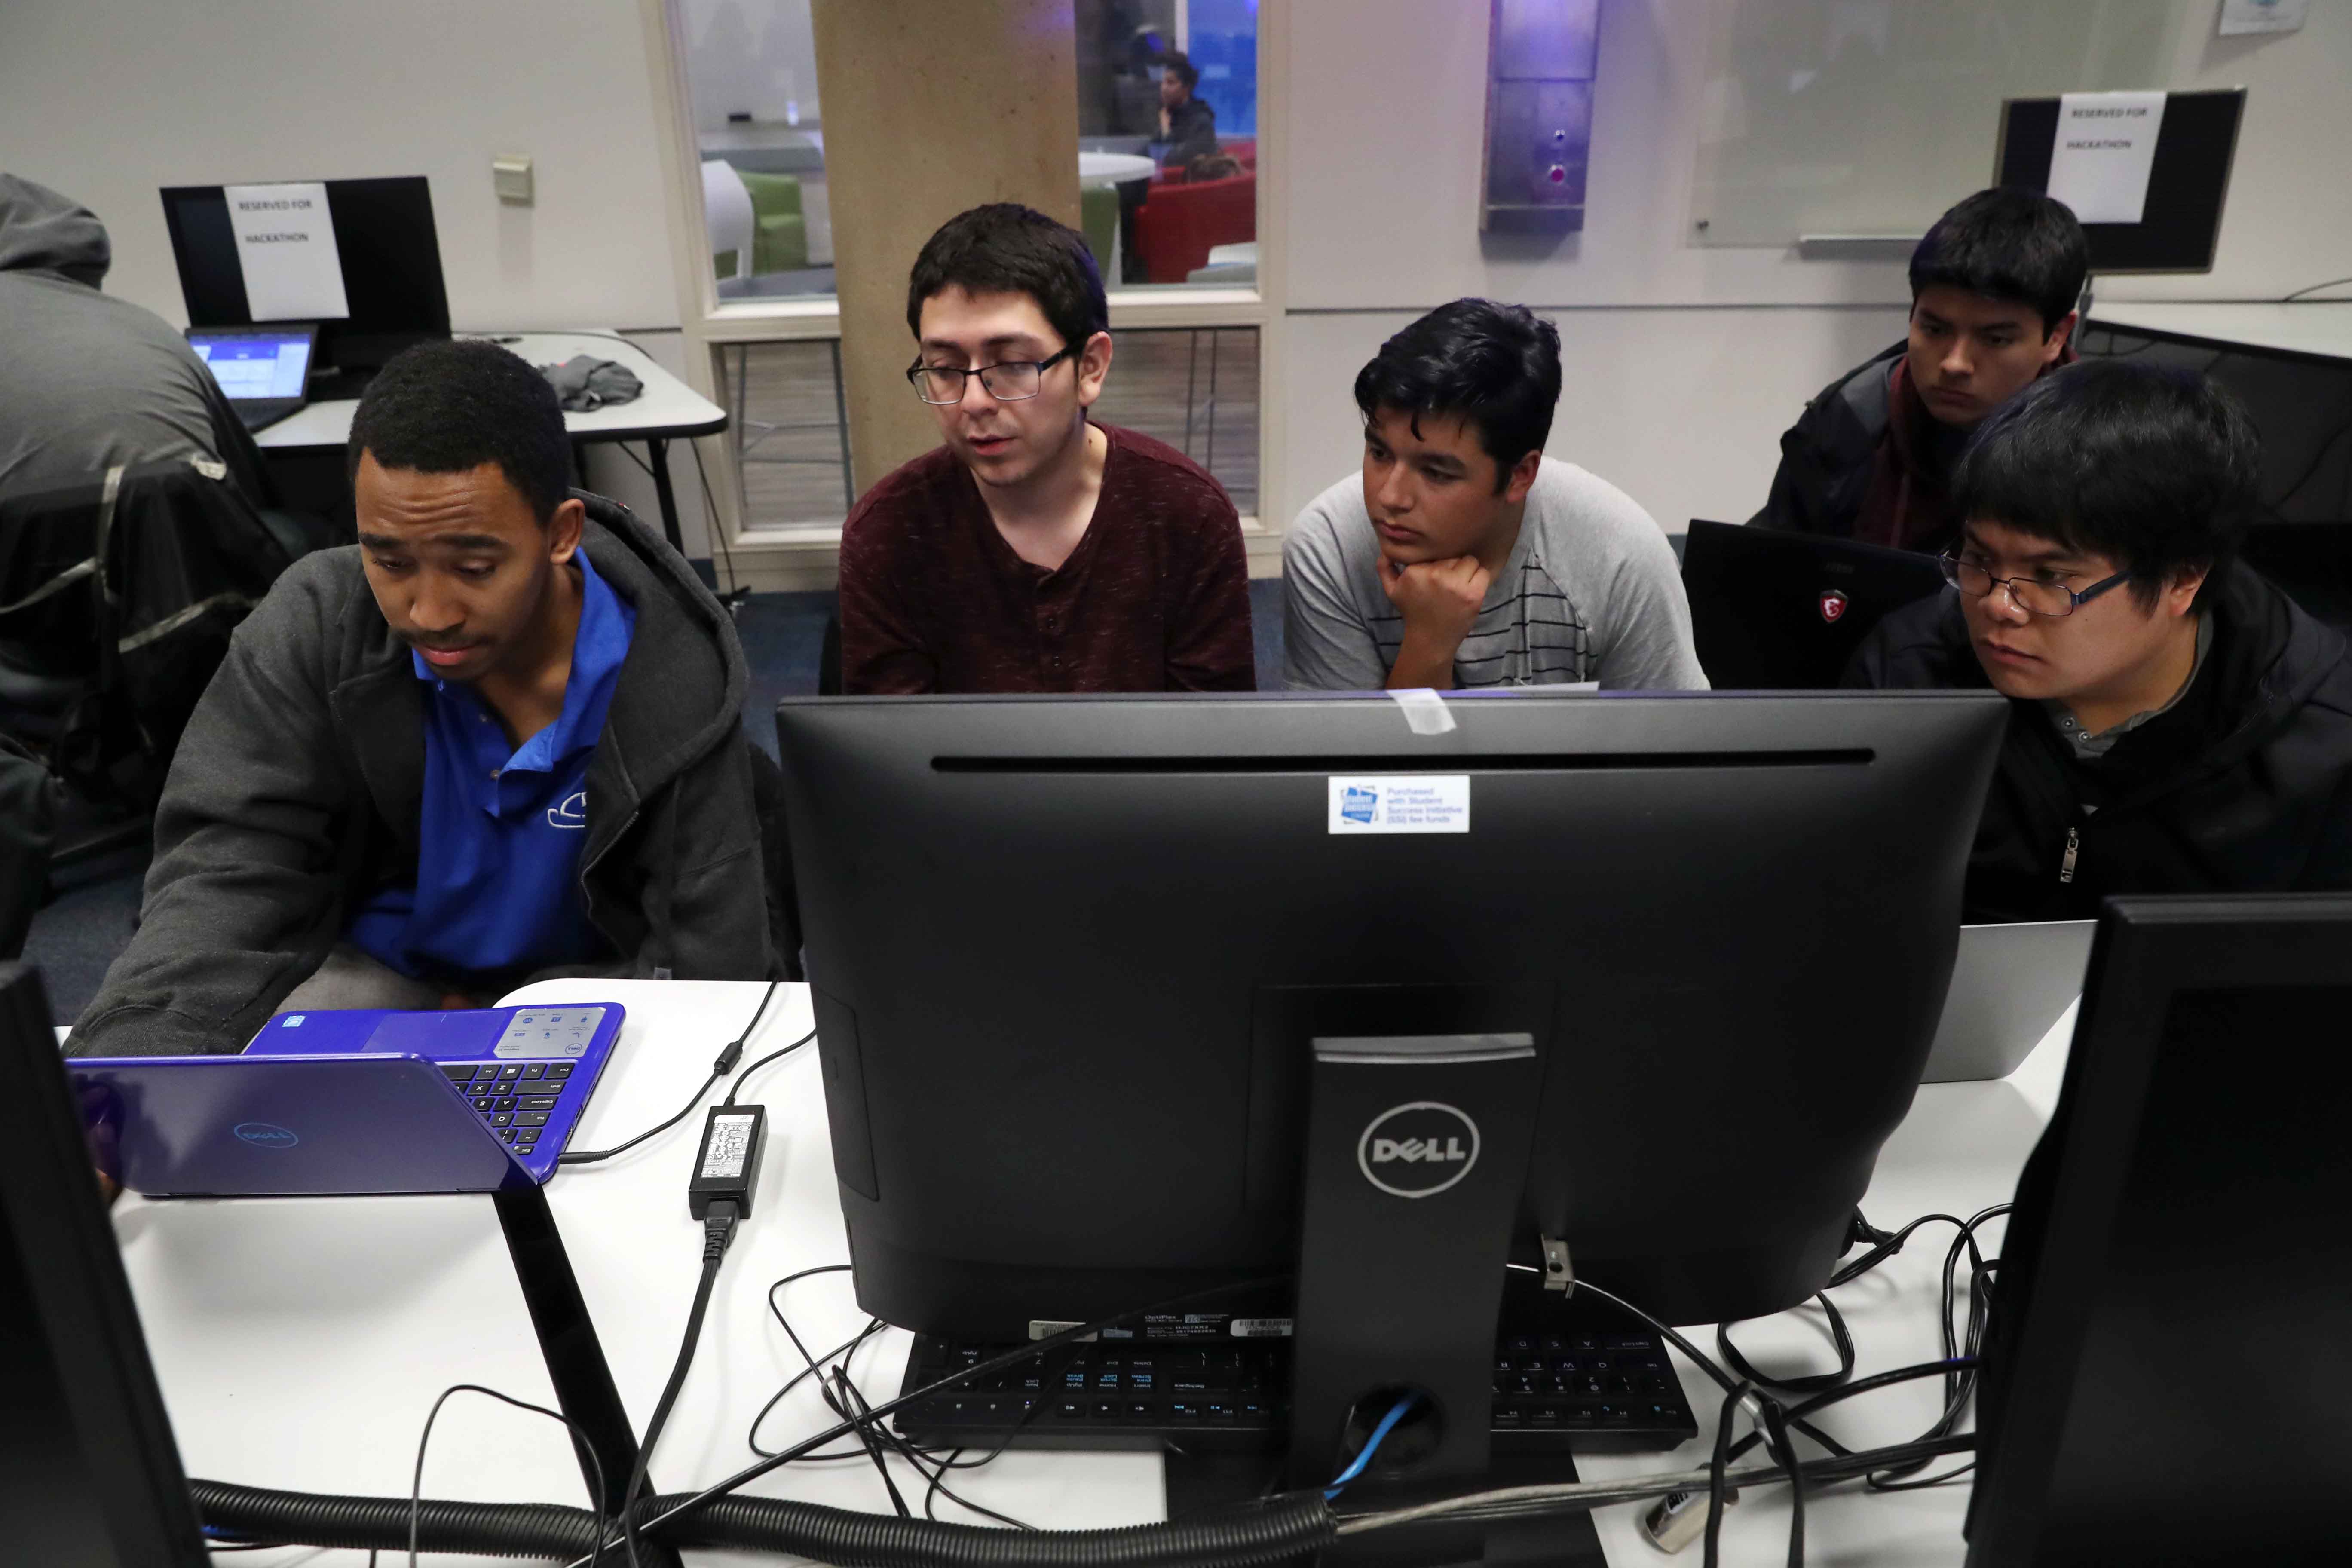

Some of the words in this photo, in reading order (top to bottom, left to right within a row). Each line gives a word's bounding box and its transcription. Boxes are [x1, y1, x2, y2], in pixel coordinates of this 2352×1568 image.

[2072, 109, 2124, 118] RESERVED
[2126, 108, 2147, 117] FOR
[2067, 140, 2131, 150] HACKATHON
[238, 200, 289, 210] RESERVED
[291, 199, 312, 209] FOR
[245, 233, 309, 243] HACKATHON
[1372, 1137, 1466, 1163] DELL
